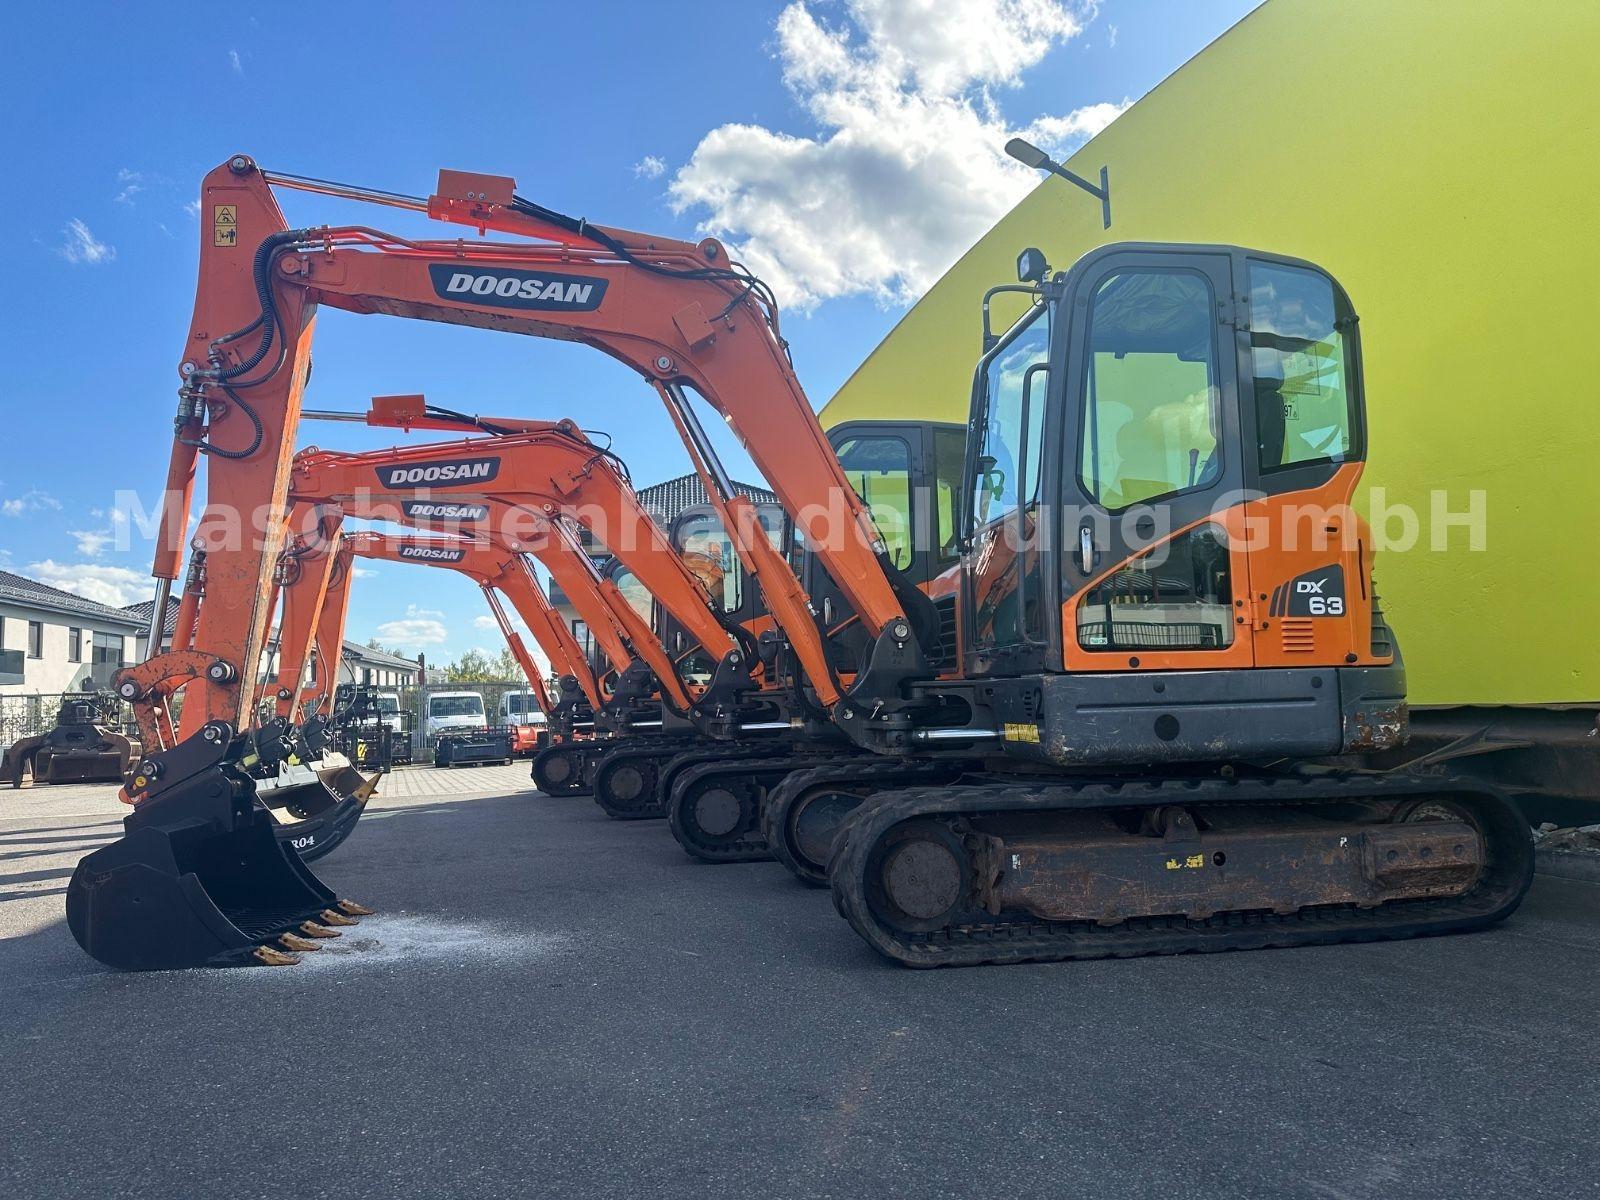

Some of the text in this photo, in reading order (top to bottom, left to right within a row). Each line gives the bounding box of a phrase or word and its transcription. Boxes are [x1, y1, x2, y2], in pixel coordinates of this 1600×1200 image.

[446, 273, 593, 304] DOOSAN
[390, 463, 491, 484] DOOSAN
[409, 504, 482, 518] DOOSAN
[403, 547, 460, 560] DOOSAN
[1296, 578, 1328, 594] DX
[1309, 596, 1343, 615] 63
